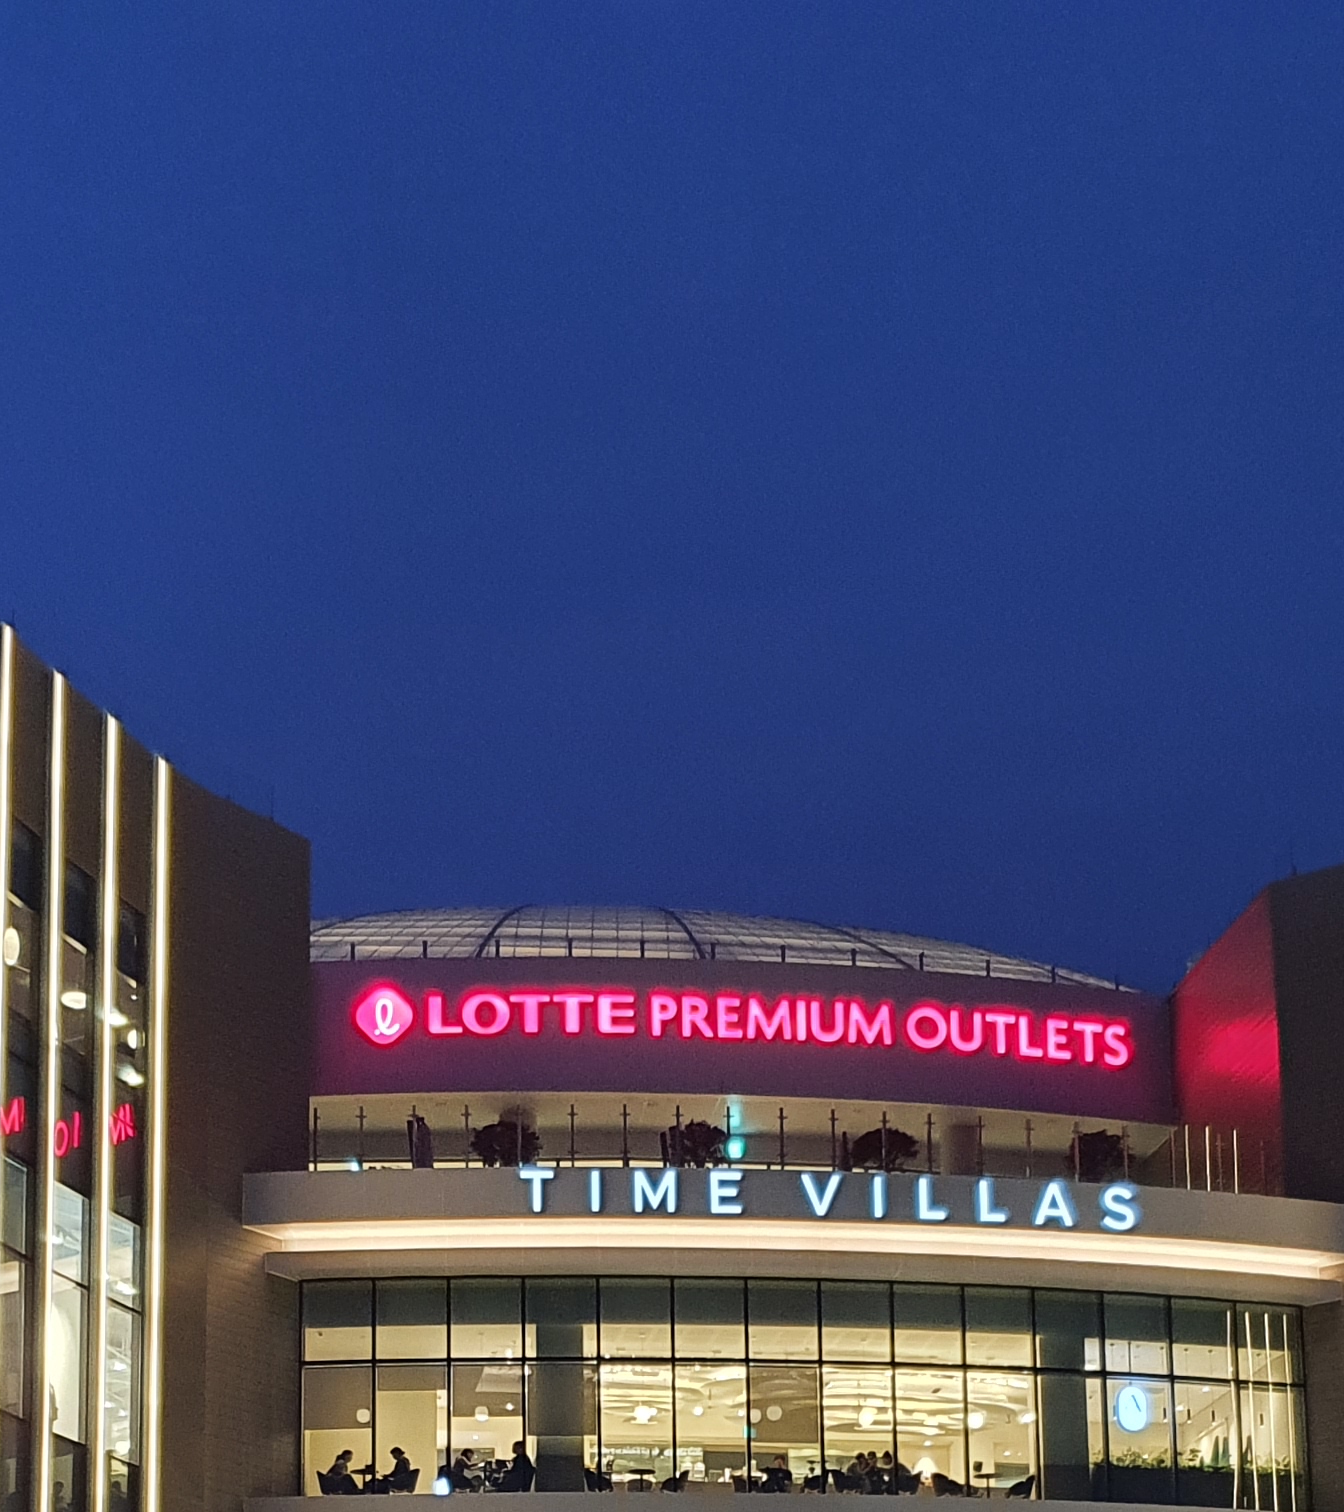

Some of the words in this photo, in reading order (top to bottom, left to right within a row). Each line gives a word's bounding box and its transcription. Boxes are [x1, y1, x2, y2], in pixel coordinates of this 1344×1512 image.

[427, 992, 636, 1036] LOTTE
[650, 994, 893, 1046] PREMIUM
[905, 1006, 1130, 1067] OUTLETS
[518, 1169, 744, 1215] TIME
[800, 1171, 1137, 1232] VILLAS
